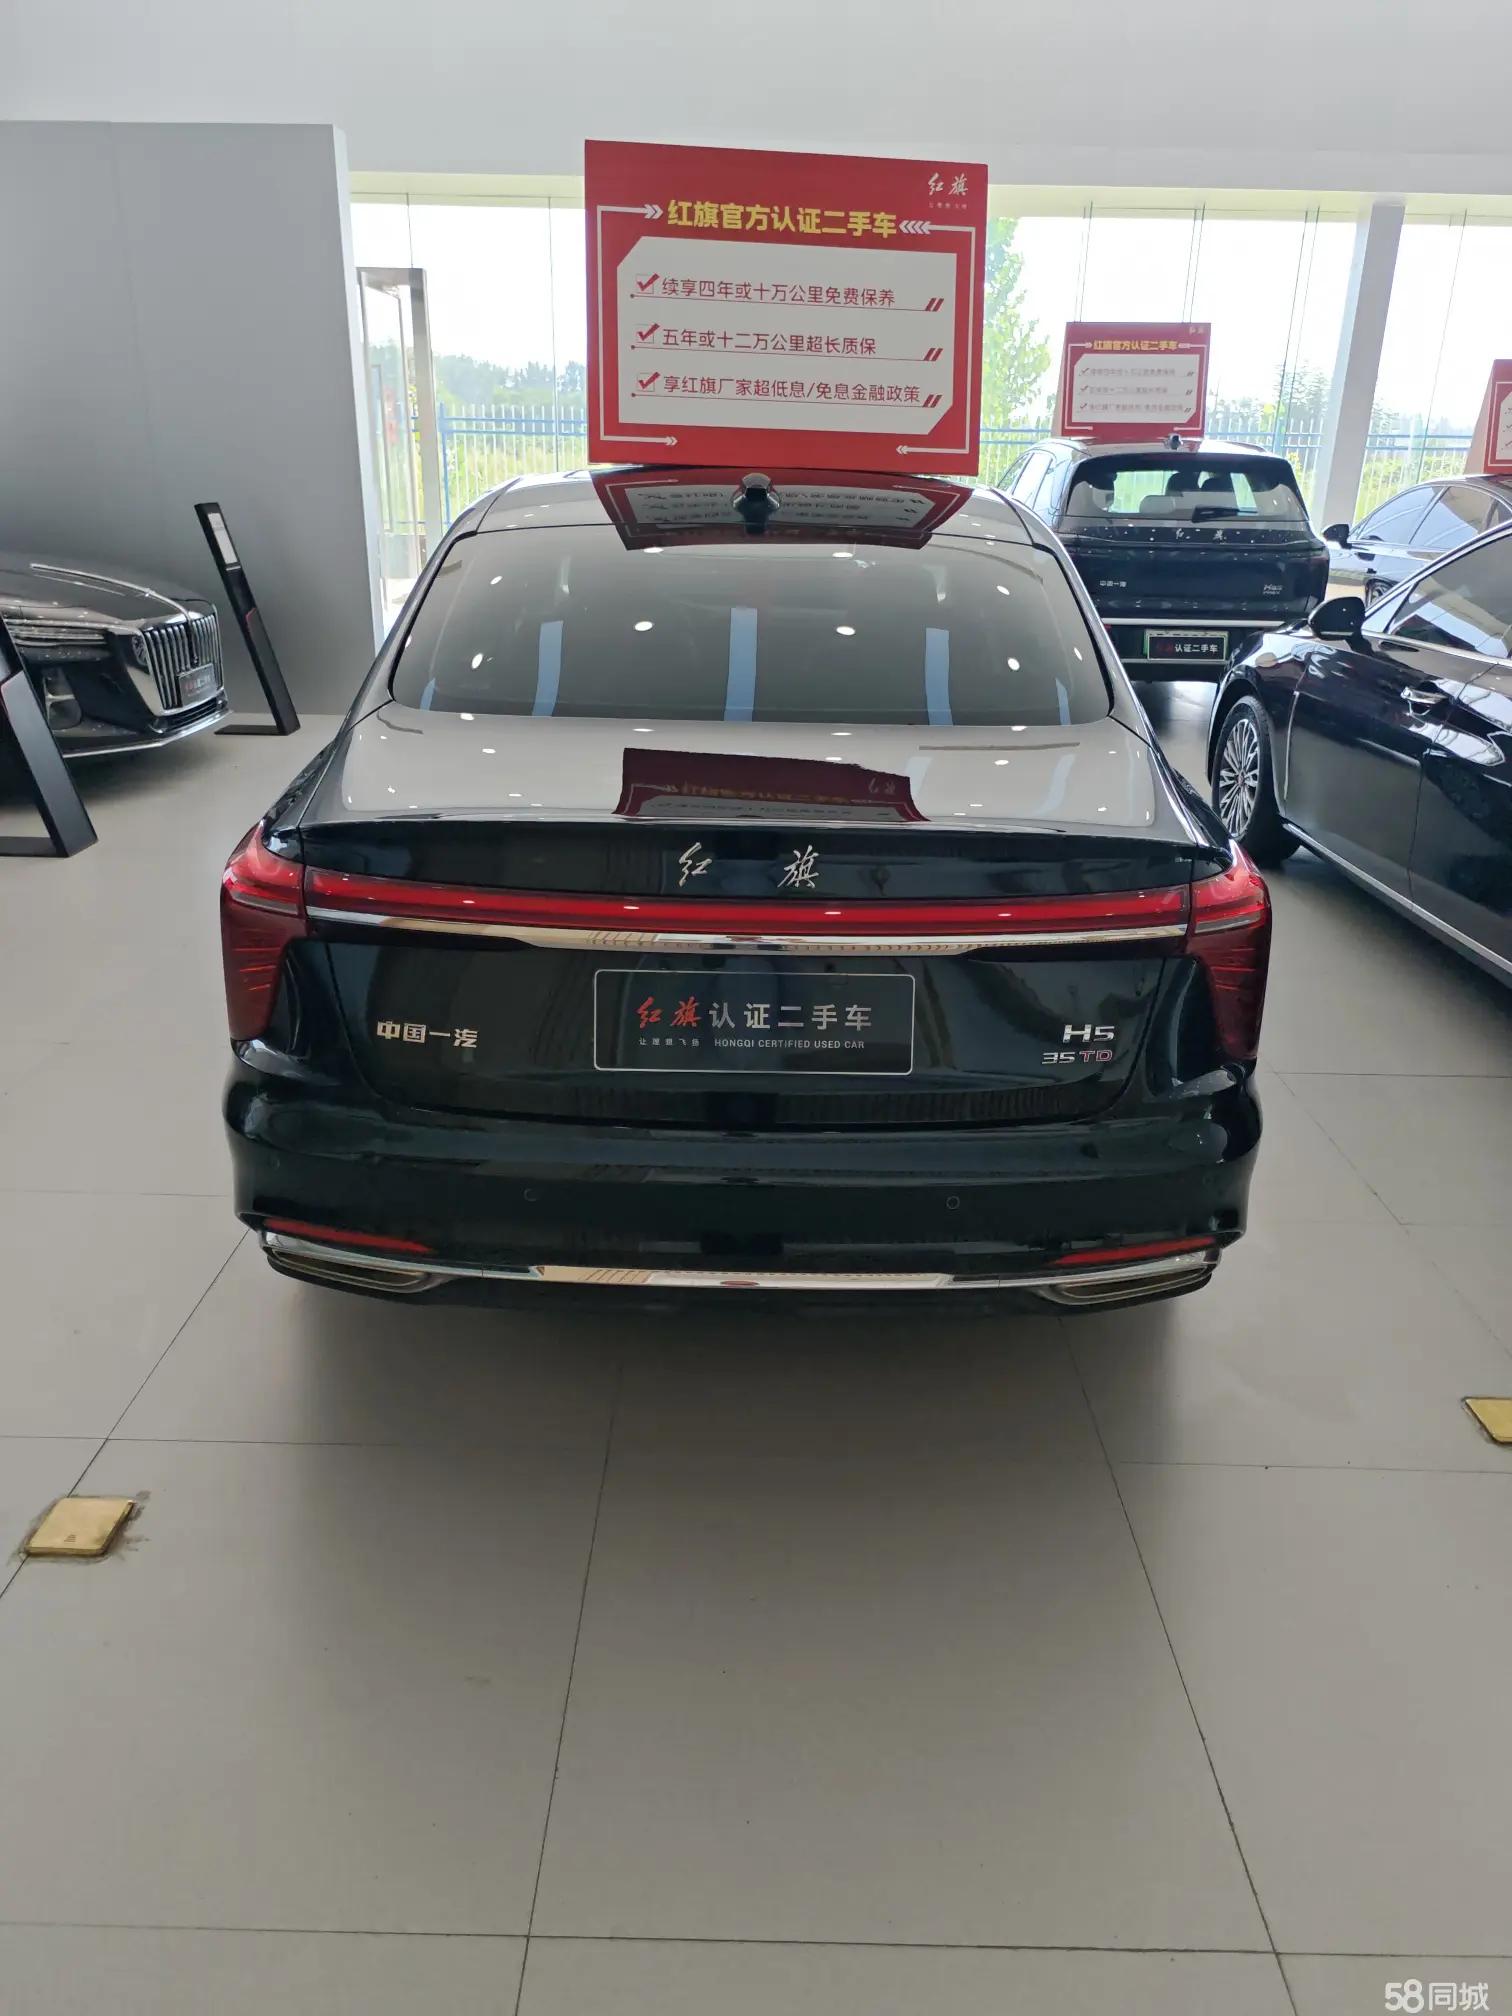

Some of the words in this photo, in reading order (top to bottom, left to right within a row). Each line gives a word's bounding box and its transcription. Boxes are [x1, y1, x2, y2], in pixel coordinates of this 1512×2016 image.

[928, 172, 968, 196] 红旗
[667, 200, 897, 238] 红旗官方认证二手车
[661, 277, 895, 307] 续享四年或十万公里免费保养
[662, 328, 876, 355] 五年或十二万公里超长质保
[663, 375, 920, 403] 享红旗厂家超低息/免息金融政策
[678, 842, 820, 889] 红旗
[376, 1021, 479, 1048] 中国一汽
[714, 1039, 755, 1048] HONGQI
[758, 1039, 811, 1049] CERTIFIED
[814, 1040, 841, 1049] USED
[844, 1040, 865, 1049] CAR
[1062, 1023, 1115, 1043] H5
